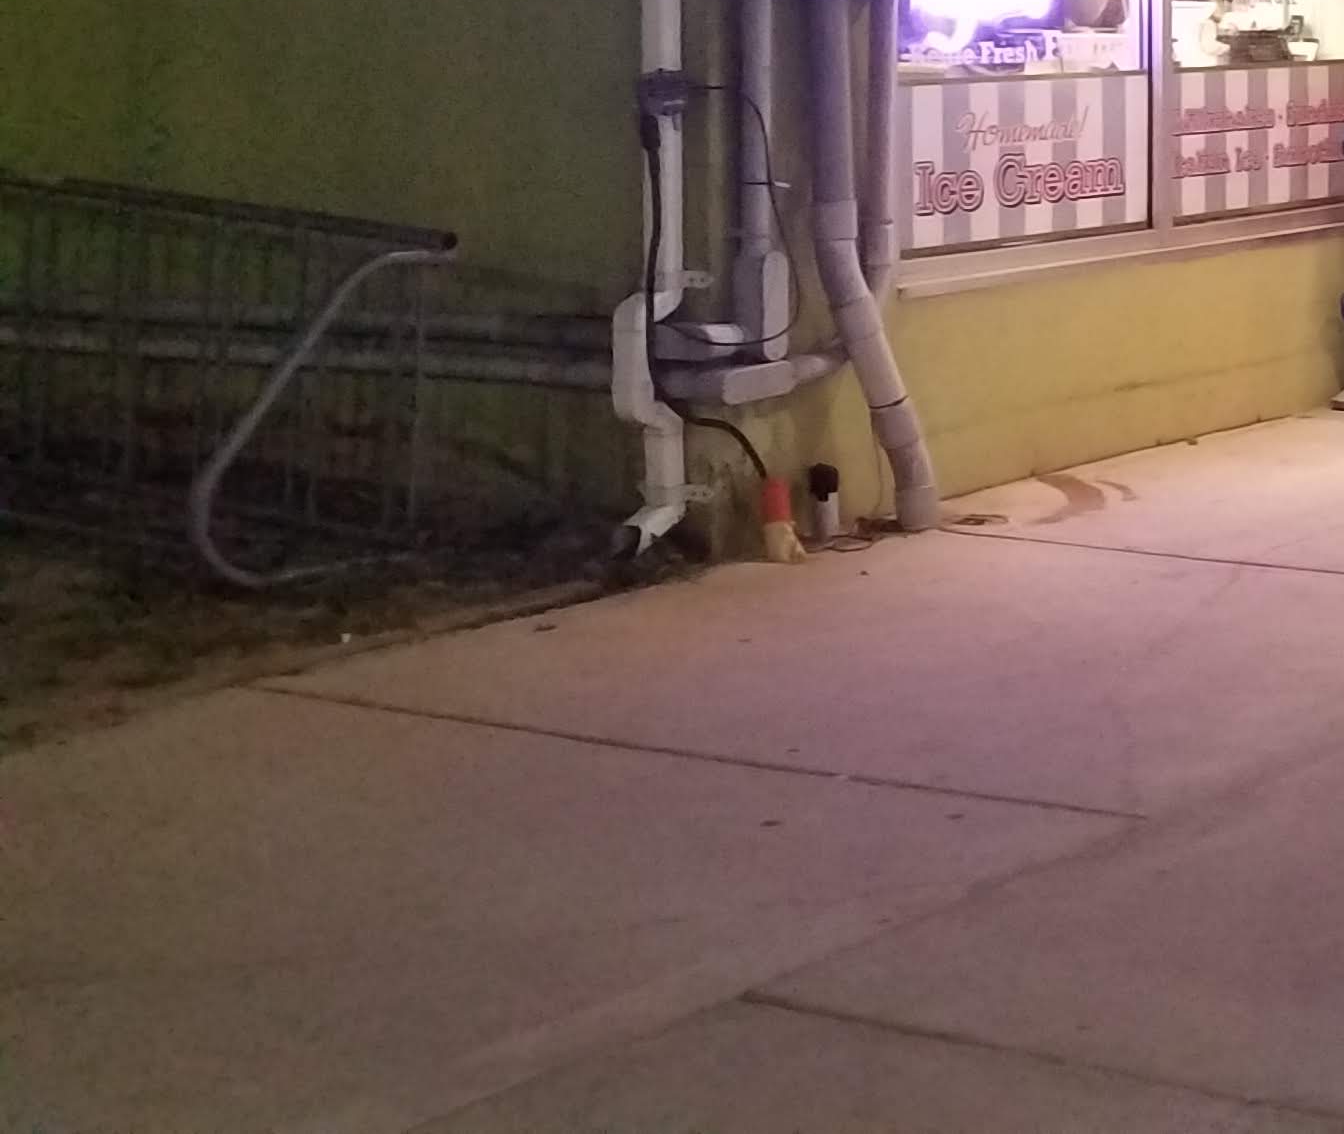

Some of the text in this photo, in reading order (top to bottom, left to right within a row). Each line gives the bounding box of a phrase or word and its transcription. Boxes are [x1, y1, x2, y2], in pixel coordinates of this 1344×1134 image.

[978, 40, 1038, 65] Fresh
[914, 152, 1127, 217] Ice Cream
